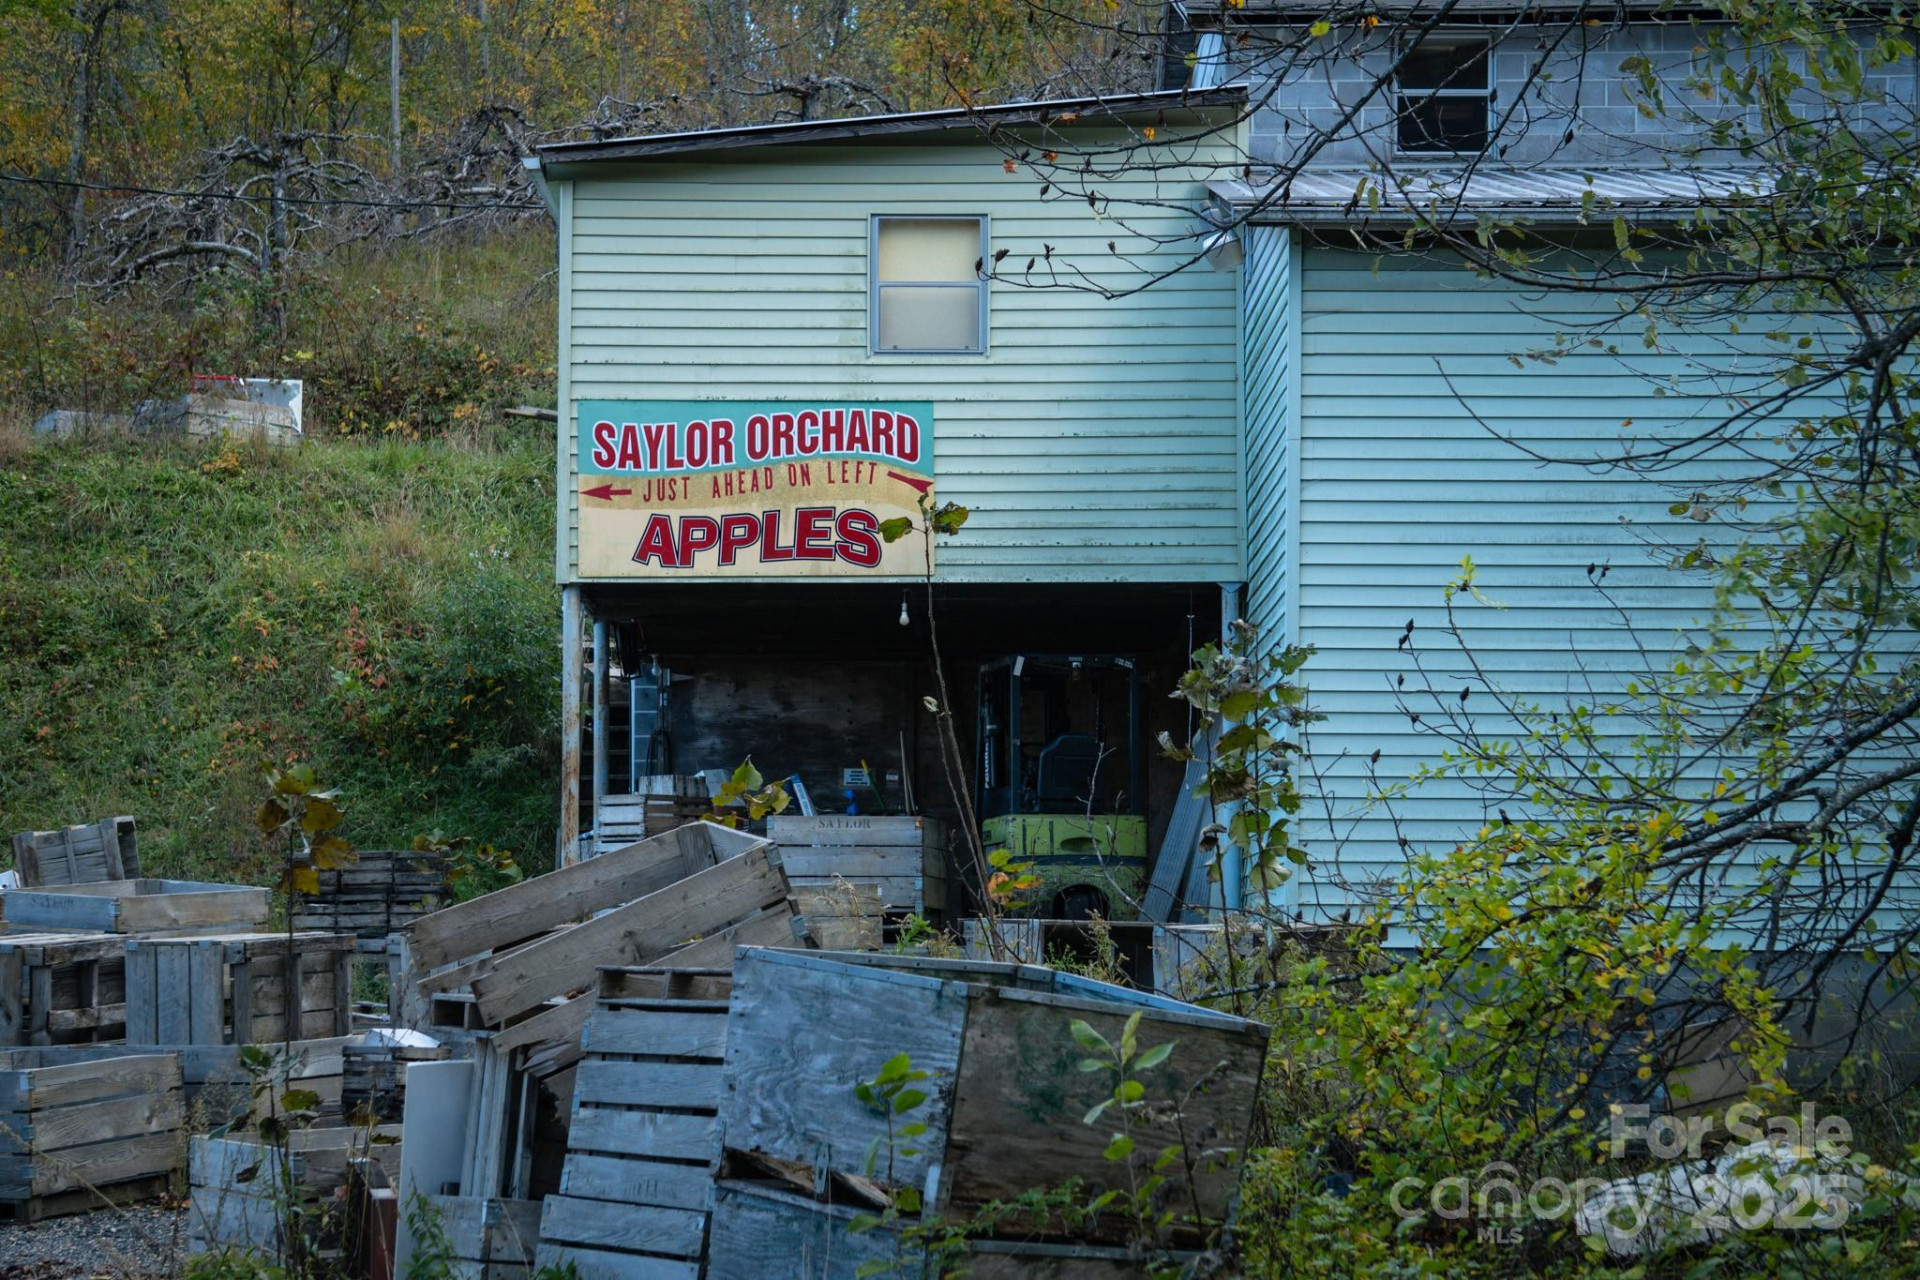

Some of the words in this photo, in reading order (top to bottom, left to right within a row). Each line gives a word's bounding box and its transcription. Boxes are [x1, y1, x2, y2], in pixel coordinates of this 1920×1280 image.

[592, 418, 736, 471] SAYLOR
[745, 408, 920, 464] ORCHARD
[643, 476, 690, 502] JUST
[712, 467, 773, 499] AHEAD
[788, 463, 811, 487] ON
[827, 461, 877, 485] LEFT
[632, 506, 882, 568] APPLES
[818, 817, 871, 829] SAYLOR
